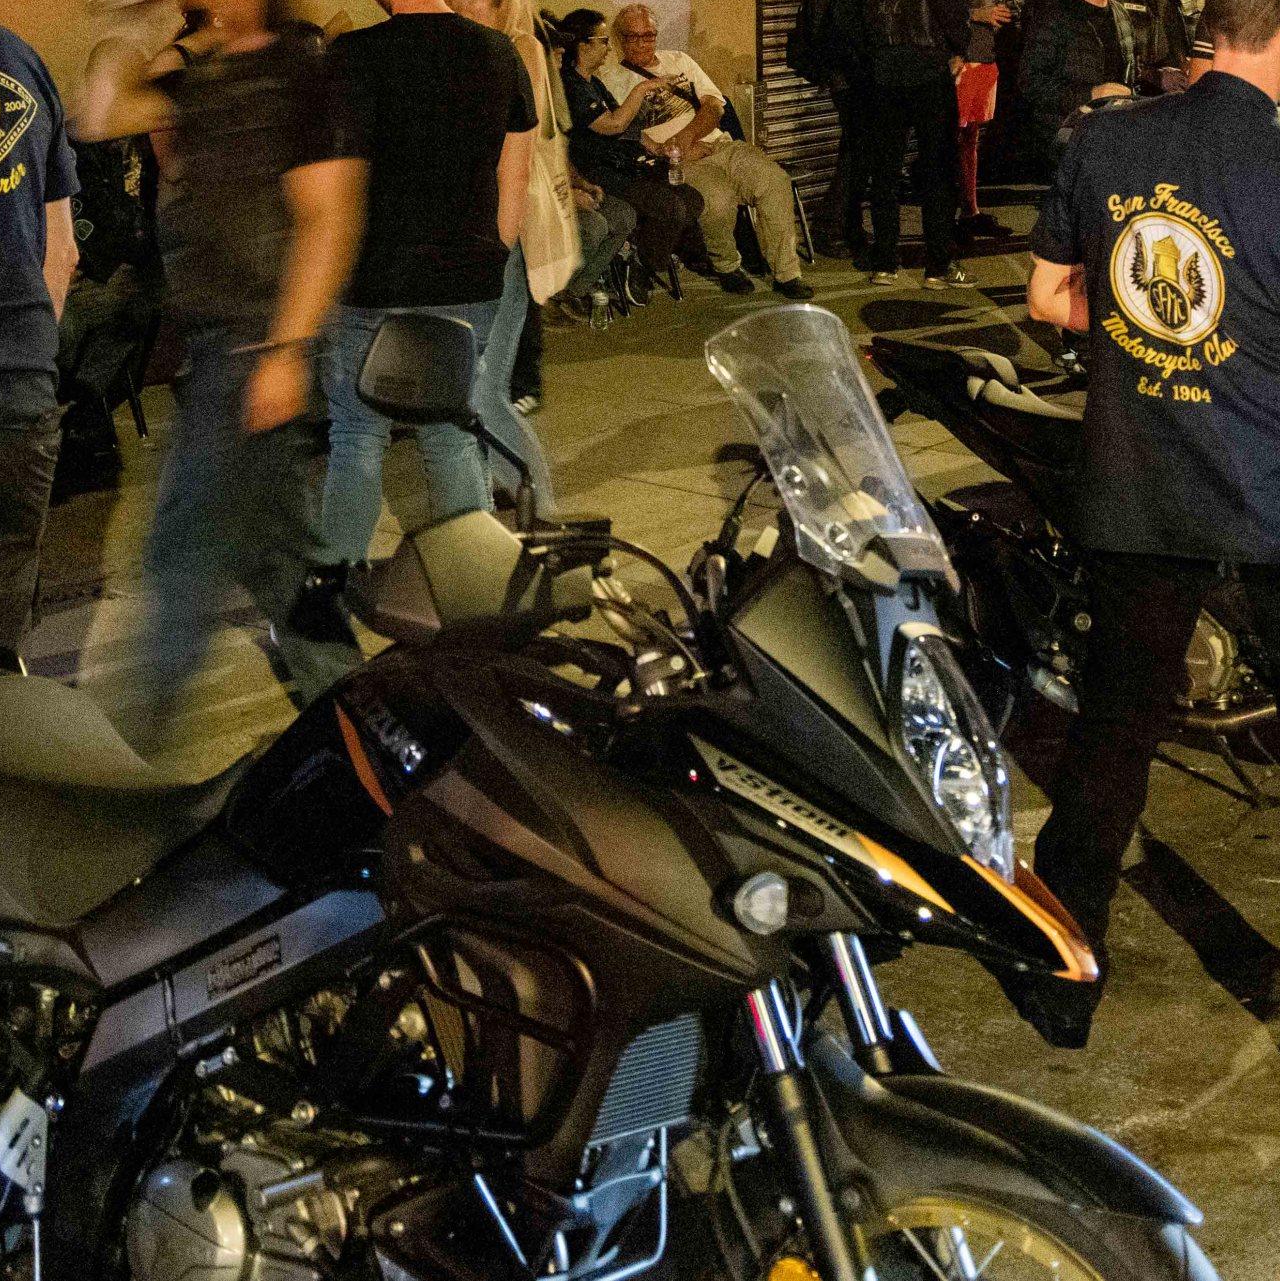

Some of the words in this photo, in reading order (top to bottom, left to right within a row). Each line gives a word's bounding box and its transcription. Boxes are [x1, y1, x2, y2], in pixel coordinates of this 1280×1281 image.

[4, 101, 26, 112] 2004
[1108, 194, 1146, 222] San
[1150, 183, 1236, 259] Francisco
[1101, 311, 1202, 378] Motorcycle
[1138, 376, 1163, 398] Est.
[1173, 384, 1212, 404] 1904
